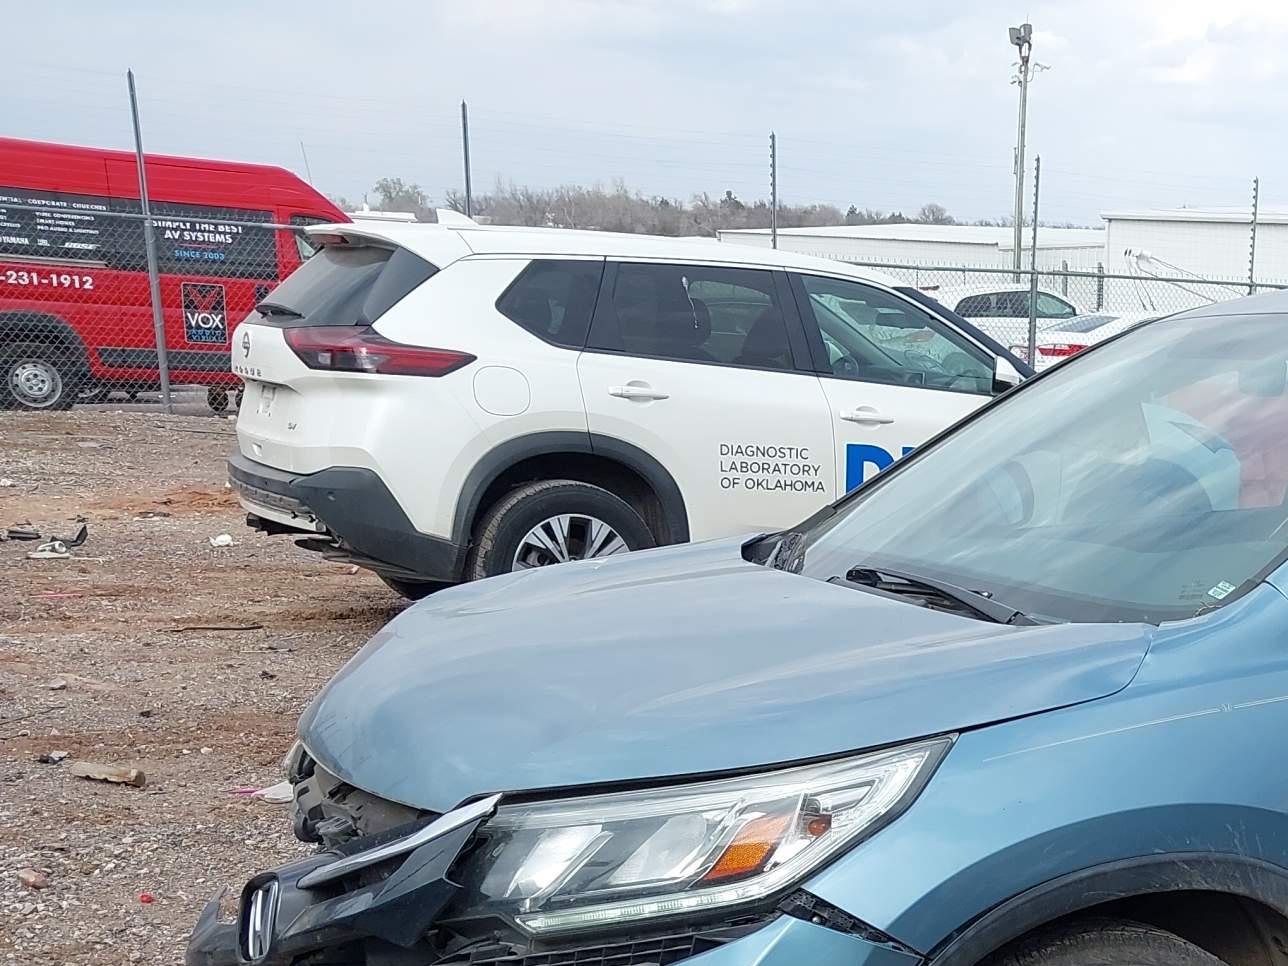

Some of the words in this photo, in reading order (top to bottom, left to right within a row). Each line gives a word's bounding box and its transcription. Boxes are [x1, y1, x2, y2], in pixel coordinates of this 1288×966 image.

[27, 199, 67, 207] CORPORATE
[72, 203, 107, 211] CHURCHES
[164, 229, 180, 240] AV
[183, 230, 233, 244] SYSTEMS
[218, 224, 242, 234] BEST
[174, 249, 201, 259] SINCE
[187, 312, 223, 330] VOX
[719, 443, 809, 461] DIAGNOSTIC
[719, 461, 822, 478] LABORATORY
[720, 477, 741, 489] OF
[744, 477, 826, 493] OKLAHOMA
